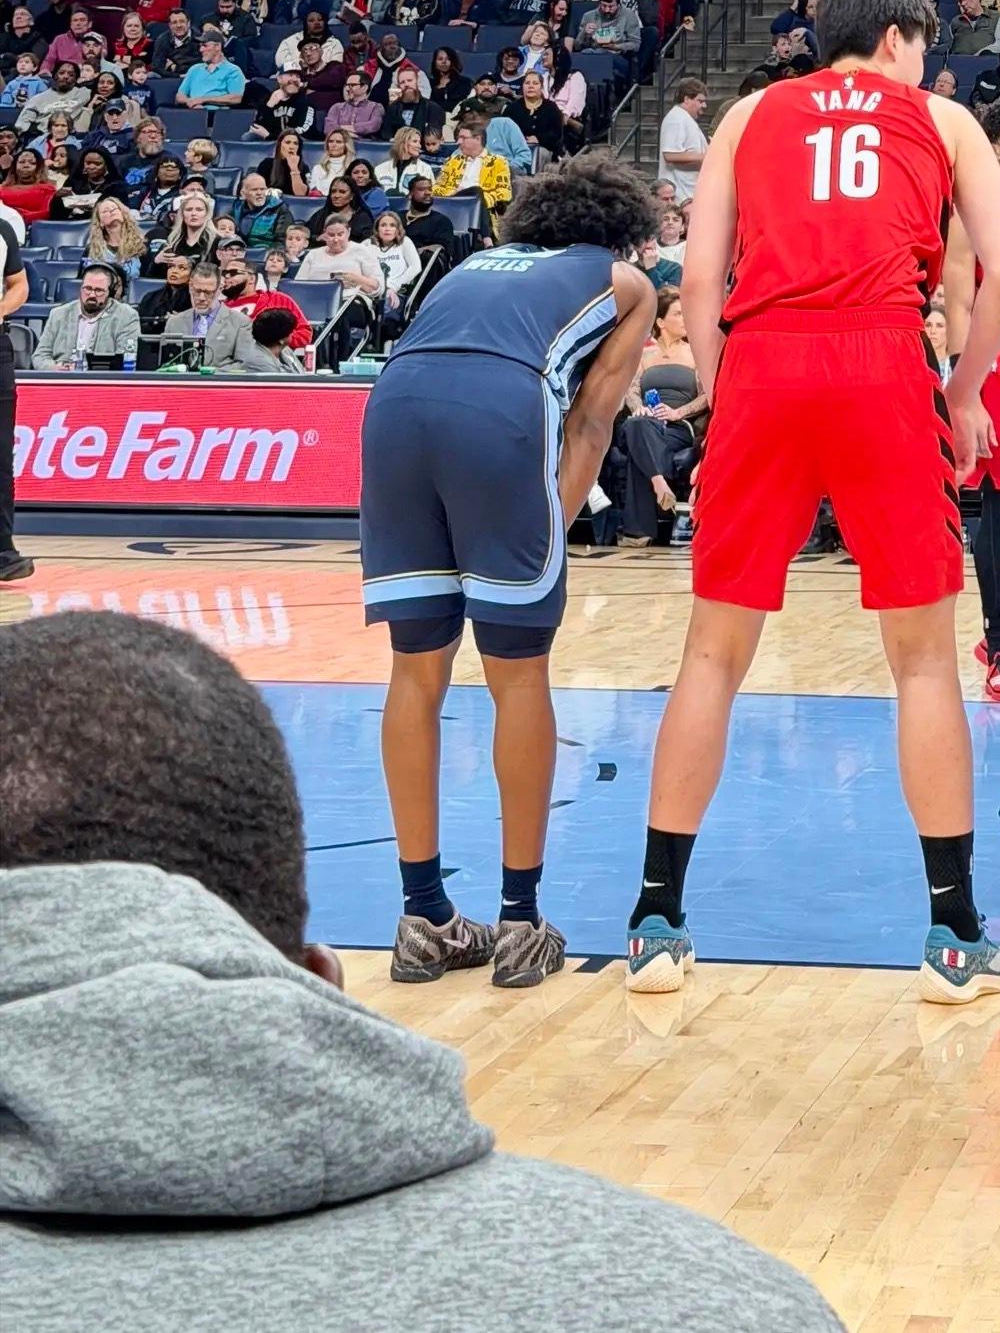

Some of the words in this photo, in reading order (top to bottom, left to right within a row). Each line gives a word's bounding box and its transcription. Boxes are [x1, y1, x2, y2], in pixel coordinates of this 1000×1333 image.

[810, 90, 884, 112] YANG
[804, 123, 882, 202] 16
[463, 258, 535, 272] WELLS
